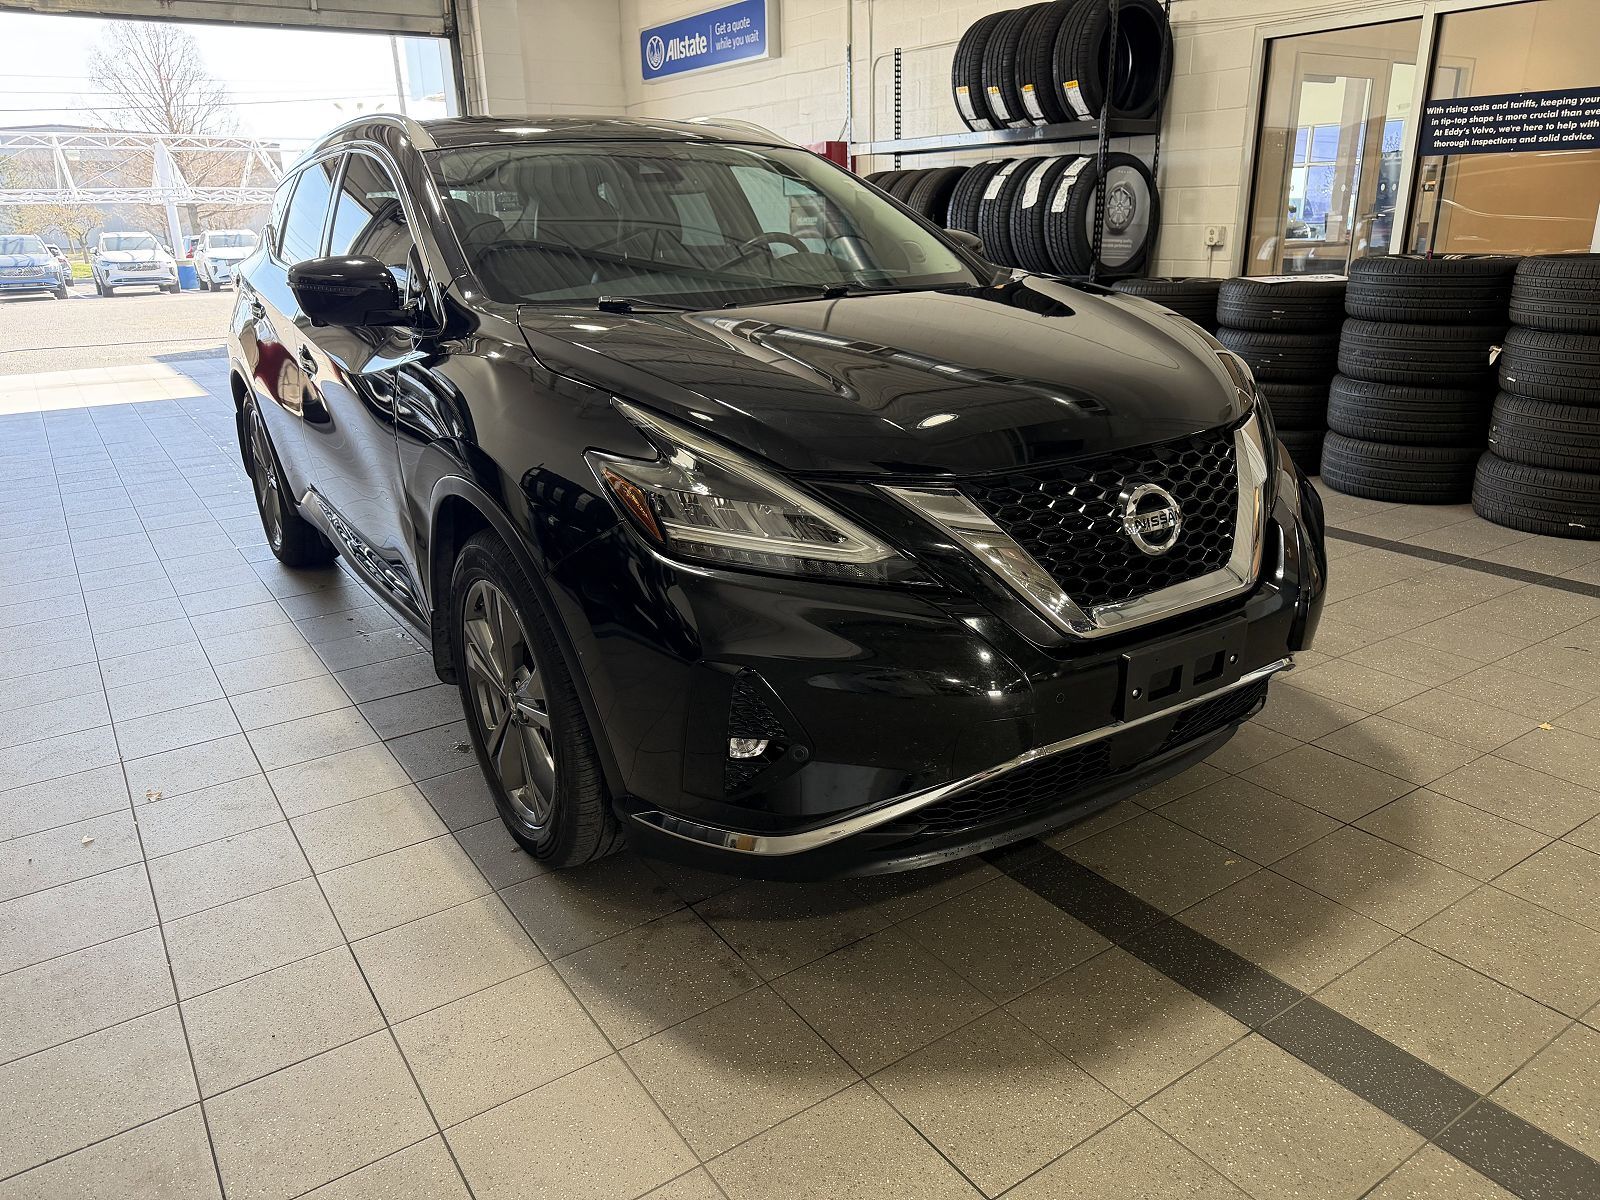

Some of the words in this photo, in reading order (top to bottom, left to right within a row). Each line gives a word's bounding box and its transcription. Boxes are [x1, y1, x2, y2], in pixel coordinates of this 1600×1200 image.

[715, 22, 727, 35] Get
[732, 17, 750, 34] quote
[666, 33, 707, 62] Allstate
[715, 34, 732, 50] while
[732, 36, 744, 50] you
[745, 29, 759, 43] wait
[1426, 106, 1444, 115] With
[1445, 105, 1469, 114] rising
[1470, 103, 1490, 112] costs
[1491, 101, 1509, 110] and
[1510, 99, 1539, 109] tariffs,
[1541, 97, 1578, 107] keeping
[1579, 96, 1600, 105] your
[1431, 118, 1439, 126] in
[1440, 117, 1467, 126] tip-top
[1469, 115, 1494, 124] shape
[1505, 113, 1528, 121] more
[1529, 109, 1559, 119] crucial
[1561, 108, 1582, 117] than
[1433, 128, 1443, 137] At
[1444, 127, 1470, 137] Eddy's
[1471, 126, 1496, 135] Volvo,
[1498, 125, 1521, 133] we're
[1523, 123, 1544, 132] here
[1557, 121, 1578, 130] help
[1580, 119, 1600, 128] with
[1433, 138, 1470, 148] thorough
[1471, 137, 1517, 147] inspections
[1518, 135, 1537, 144] and
[1538, 133, 1561, 143] solid
[1562, 132, 1595, 141] advice.
[1134, 511, 1182, 529] NISSAN
